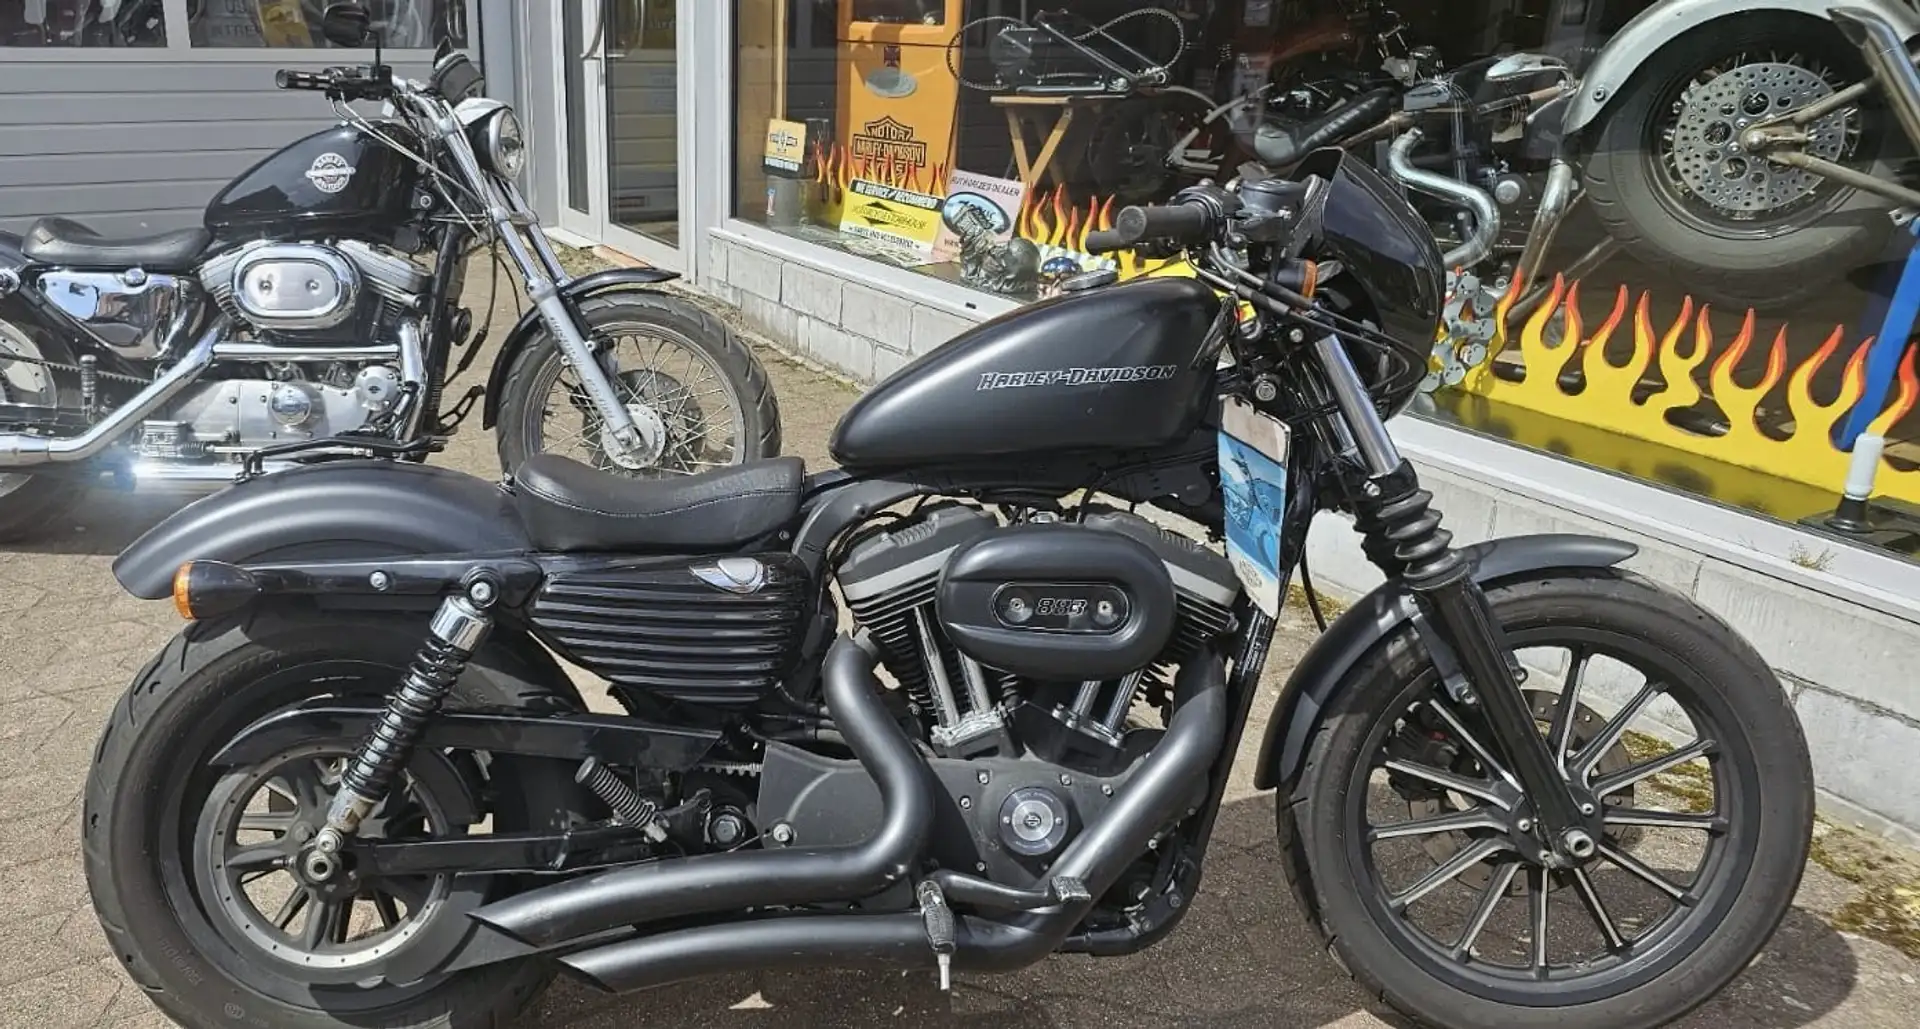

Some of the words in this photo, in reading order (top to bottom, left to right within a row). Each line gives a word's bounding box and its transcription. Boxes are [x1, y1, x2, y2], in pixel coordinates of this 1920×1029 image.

[871, 123, 906, 140] MOTOR
[976, 365, 1177, 391] HARLEY-DAVIDSON
[1036, 598, 1088, 616] 883
